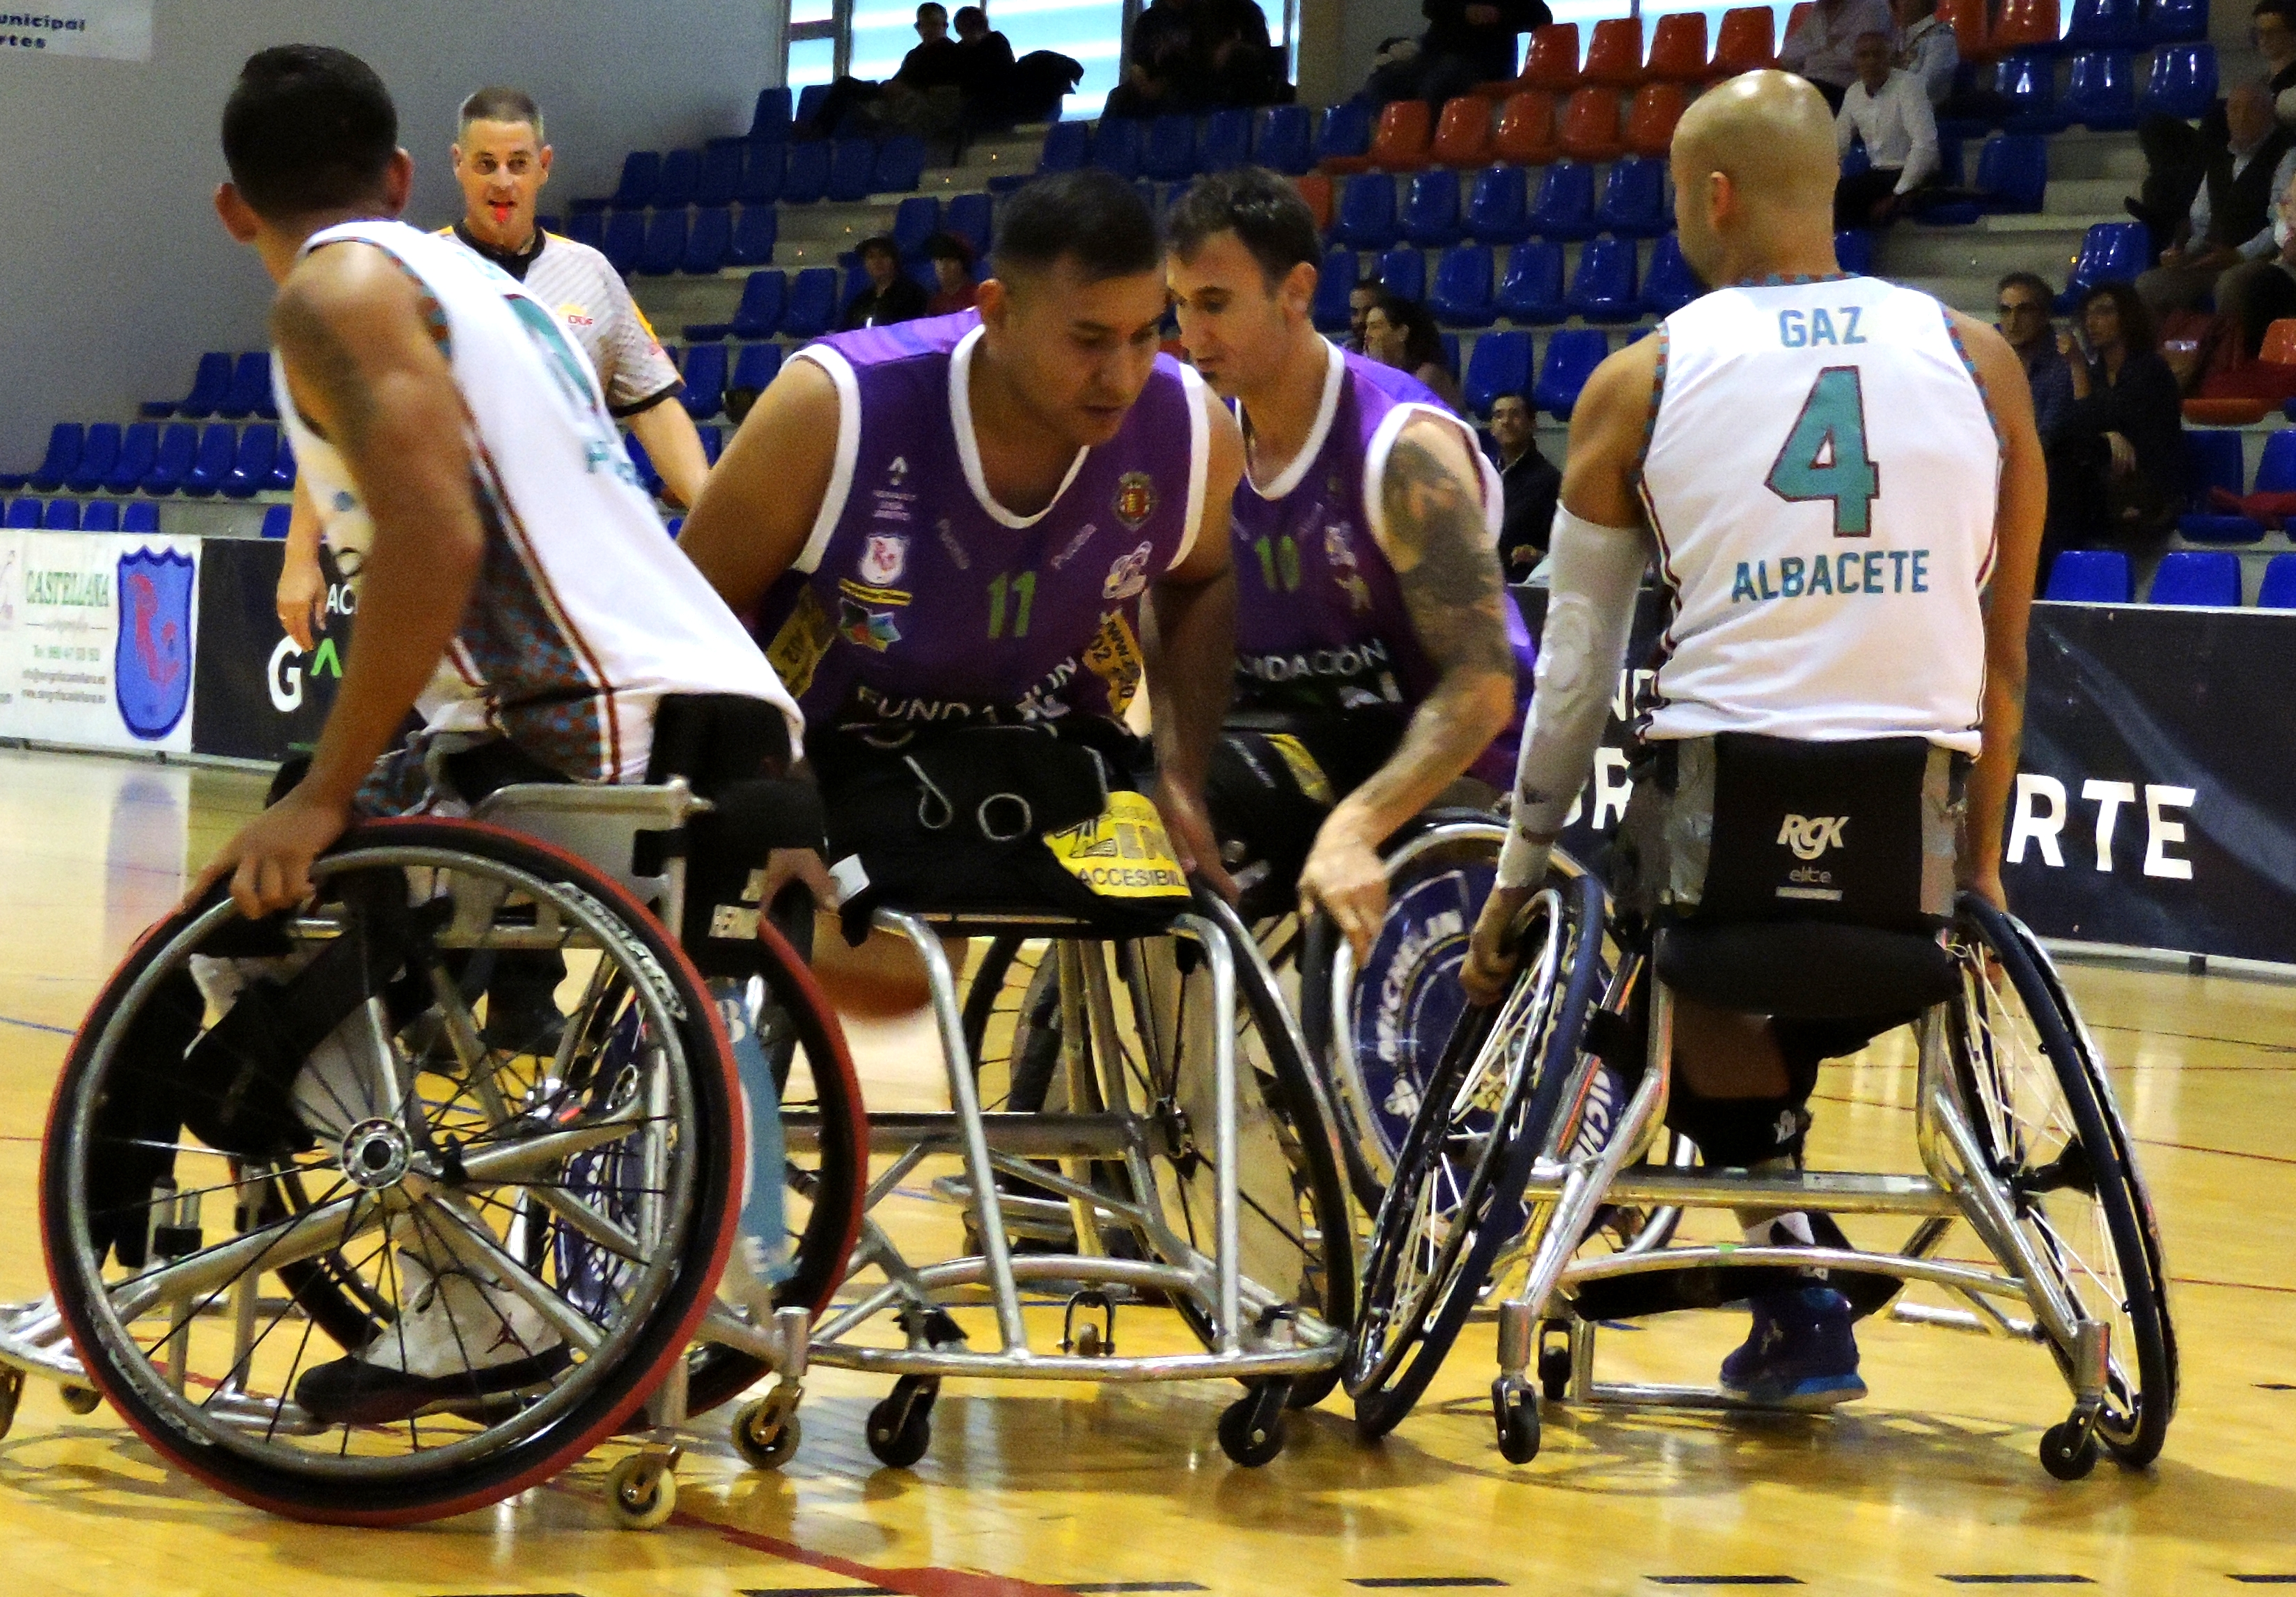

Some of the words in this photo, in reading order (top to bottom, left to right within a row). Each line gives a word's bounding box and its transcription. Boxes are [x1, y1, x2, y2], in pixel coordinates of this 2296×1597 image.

[1779, 306, 1868, 348] GAZ
[1764, 365, 1880, 538] 4
[1731, 550, 1930, 603] ALBACETE
[987, 571, 1036, 639] 11
[1776, 813, 1850, 860] RGK
